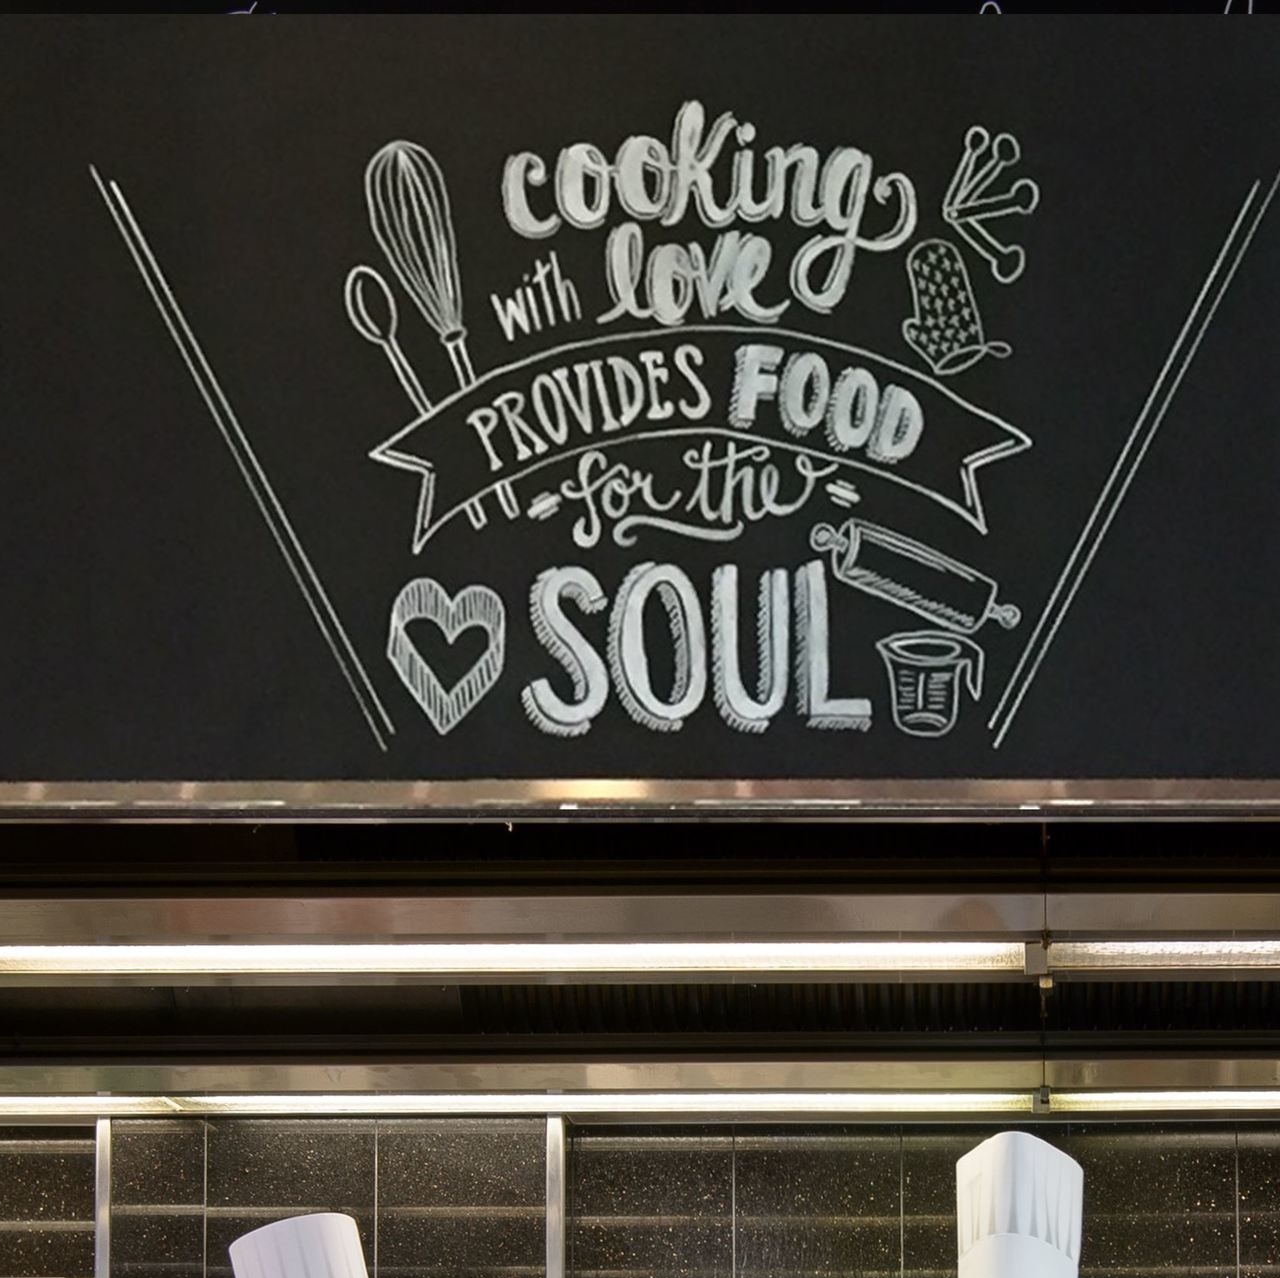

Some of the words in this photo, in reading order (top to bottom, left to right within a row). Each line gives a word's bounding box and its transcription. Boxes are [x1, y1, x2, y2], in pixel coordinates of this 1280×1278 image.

[501, 99, 918, 315] cooking
[491, 250, 582, 342] with
[596, 221, 791, 325] love
[465, 343, 711, 472] PROVIDES
[727, 343, 924, 465] FOOD
[560, 450, 682, 548] for
[683, 441, 838, 523] the
[520, 558, 873, 738] SOUL
